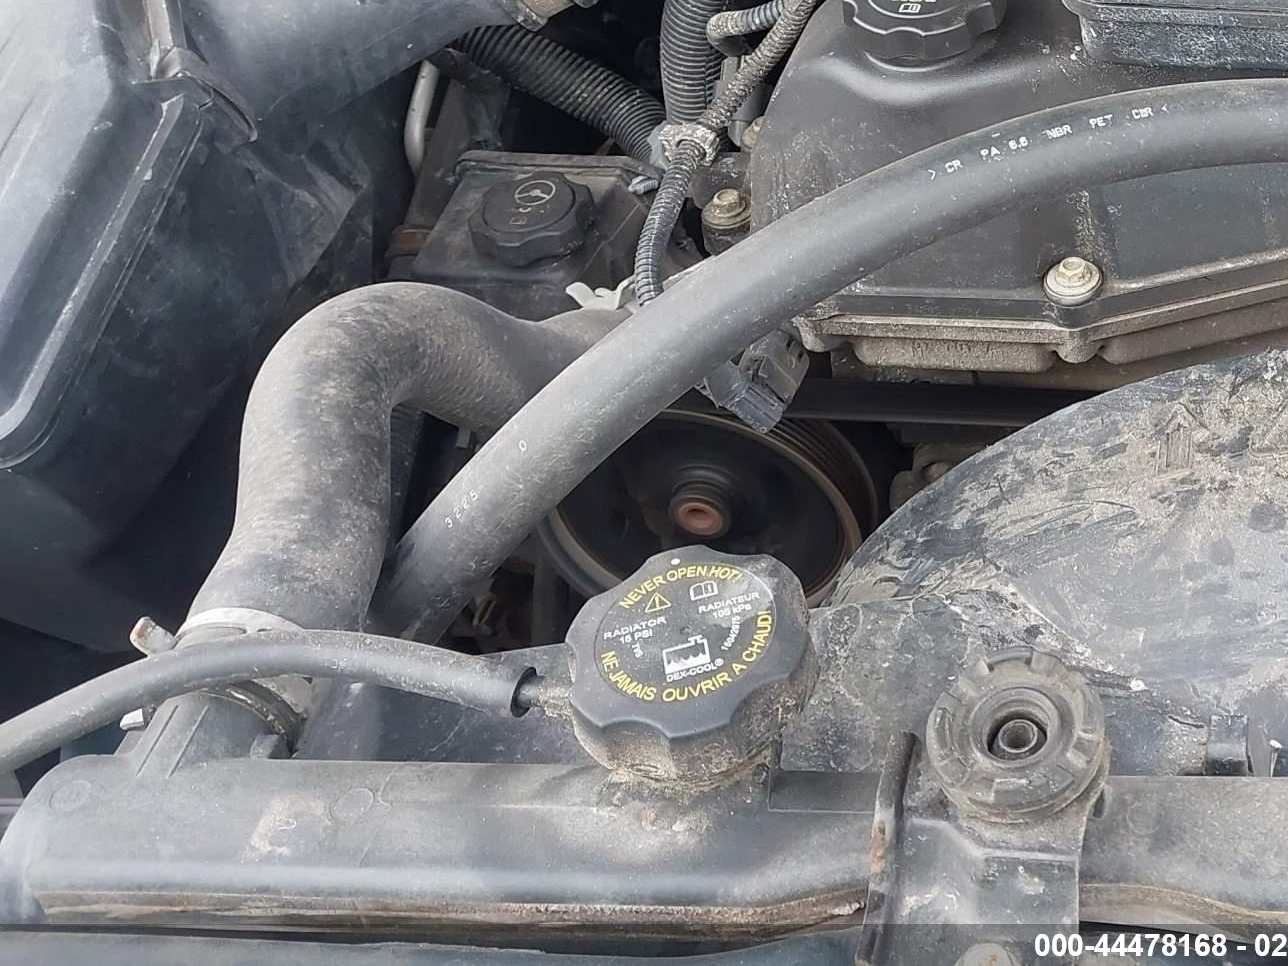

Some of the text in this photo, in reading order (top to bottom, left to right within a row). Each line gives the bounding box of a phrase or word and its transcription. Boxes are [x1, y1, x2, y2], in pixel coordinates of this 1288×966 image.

[944, 159, 963, 173] CR
[1046, 124, 1073, 139] NBR
[1088, 114, 1114, 129] PET
[618, 575, 666, 609] NEVER
[666, 566, 708, 581] OPEN
[698, 592, 760, 614] RADIATEUR
[603, 616, 667, 640] RADIATOR
[634, 629, 653, 641] PSI
[601, 650, 619, 672] NE
[608, 669, 657, 702] JAMAIS
[662, 672, 732, 702] OUVRIR
